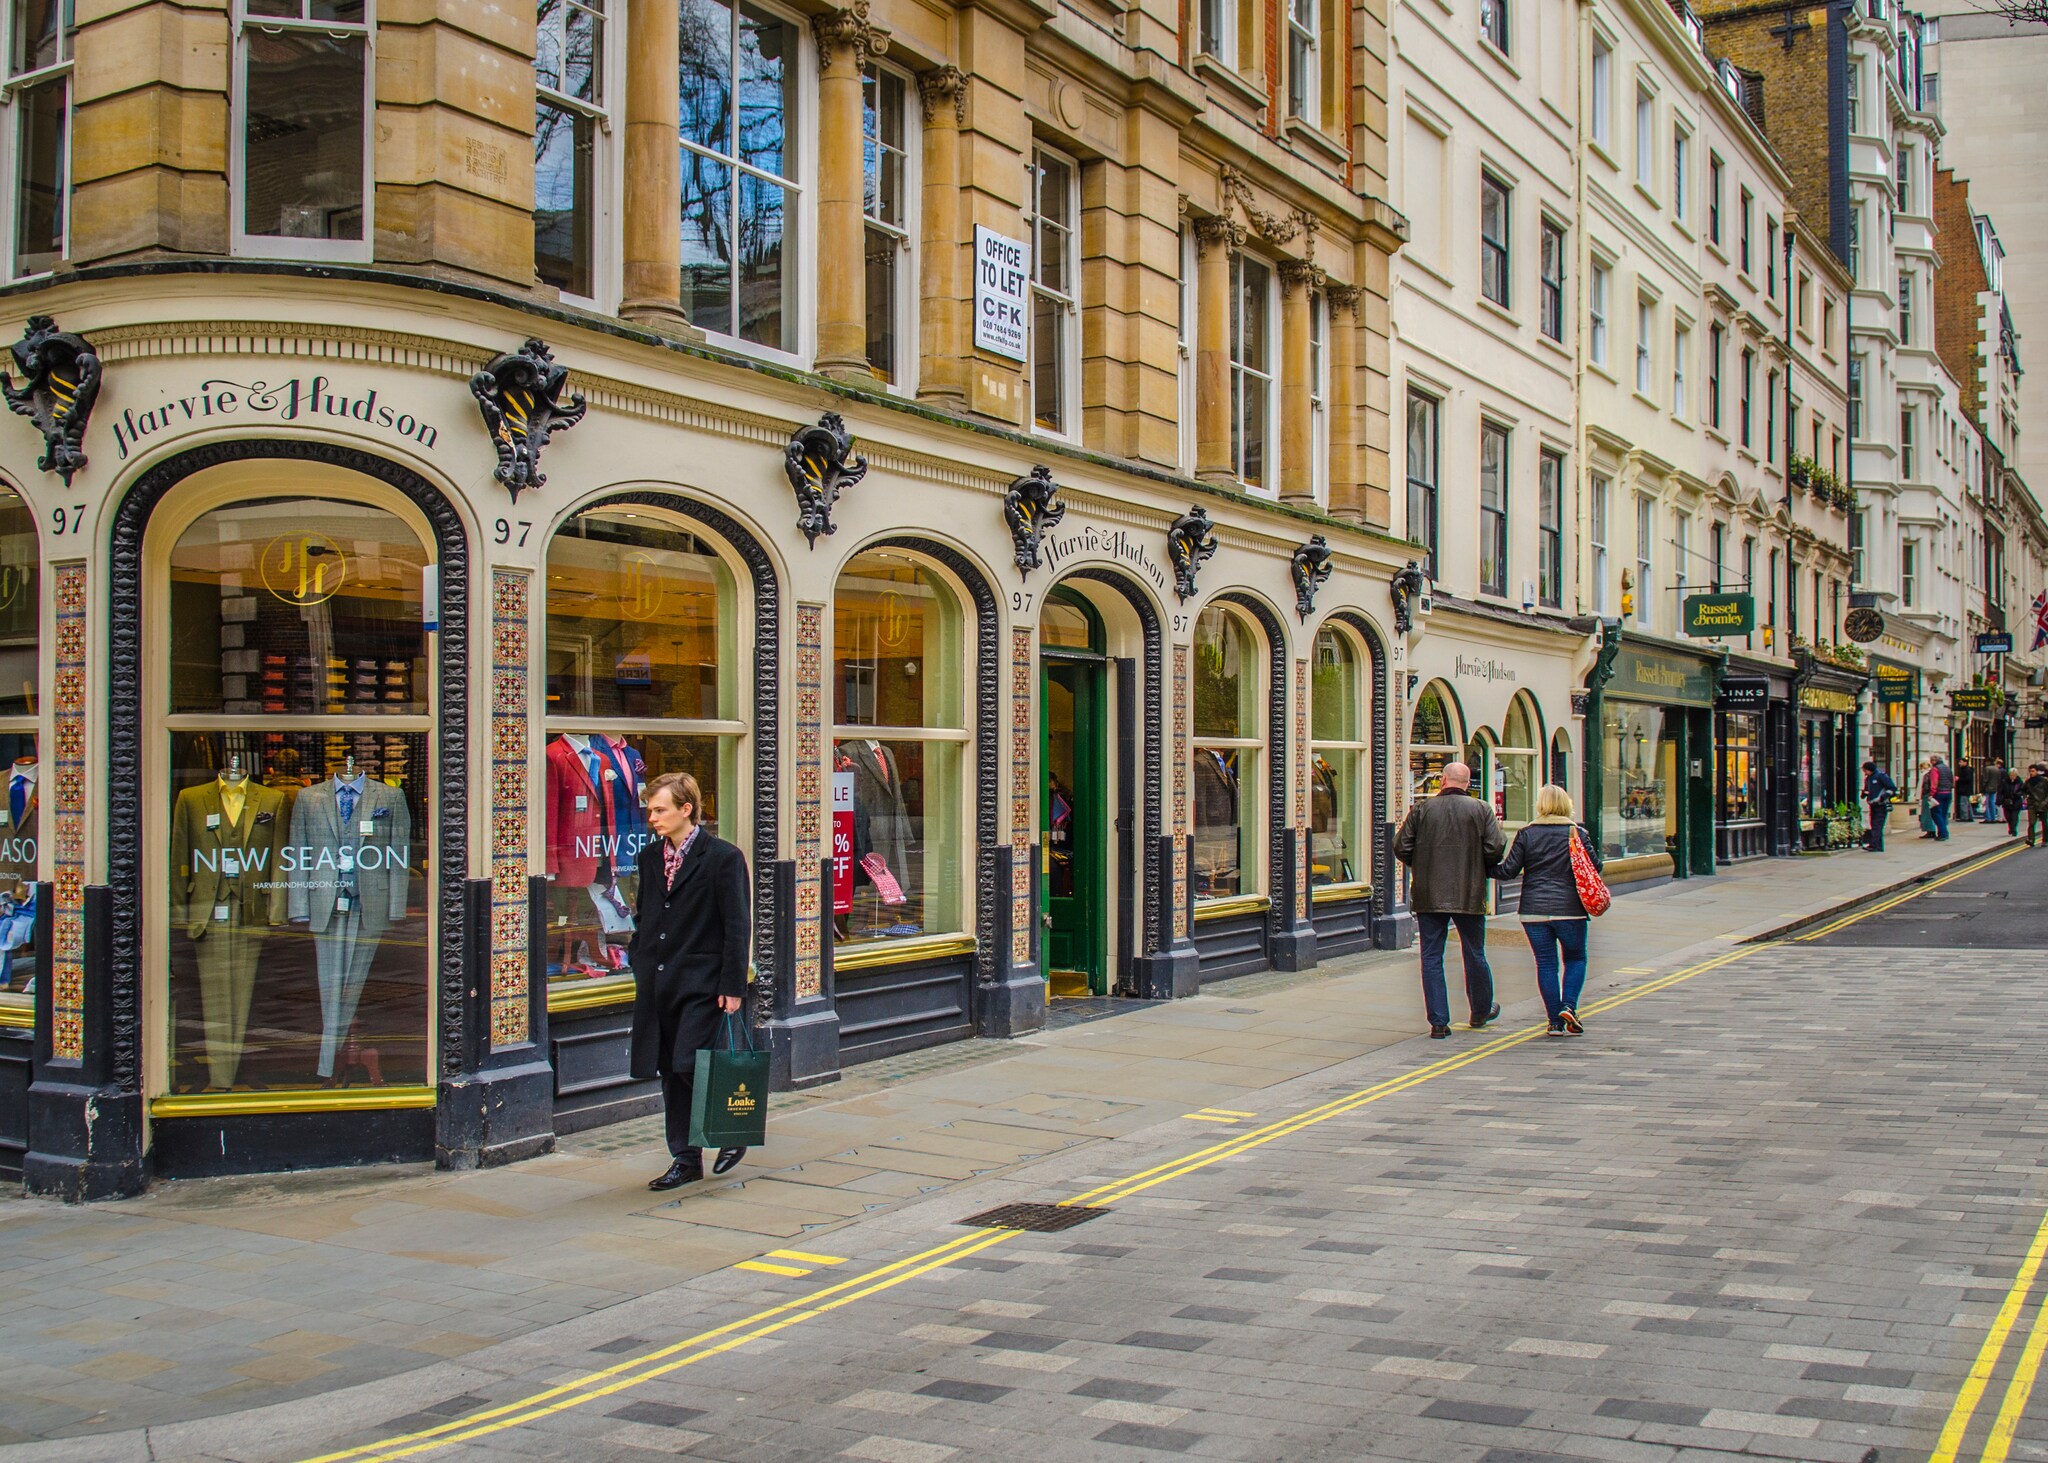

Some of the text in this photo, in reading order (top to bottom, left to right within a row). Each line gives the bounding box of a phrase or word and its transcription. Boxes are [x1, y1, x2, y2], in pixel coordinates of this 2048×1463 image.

[986, 238, 1020, 267] OFFICE
[981, 259, 1025, 297] TO LET
[983, 297, 1021, 326] CFK
[983, 320, 992, 330] 020
[112, 376, 439, 460] Harvie & Hudson
[52, 504, 87, 535] 97
[494, 518, 533, 547] 97
[1044, 527, 1165, 588] Harvie & Hudson
[1012, 592, 1033, 612] 97
[1699, 603, 1737, 615] Russell
[1173, 615, 1188, 632] 97
[1394, 646, 1404, 661] 97
[1455, 654, 1481, 678] Harvie
[1488, 660, 1516, 683] Hudson
[834, 787, 849, 801] LE
[833, 820, 842, 828] TO
[1, 838, 37, 863] ASO
[193, 848, 269, 872] NEW
[279, 845, 408, 872] SEASON
[575, 834, 622, 859] NEW
[833, 856, 849, 879] FF
[253, 880, 354, 889] HARVIEANDHUDSON.COM
[727, 1097, 756, 1107] Loake
